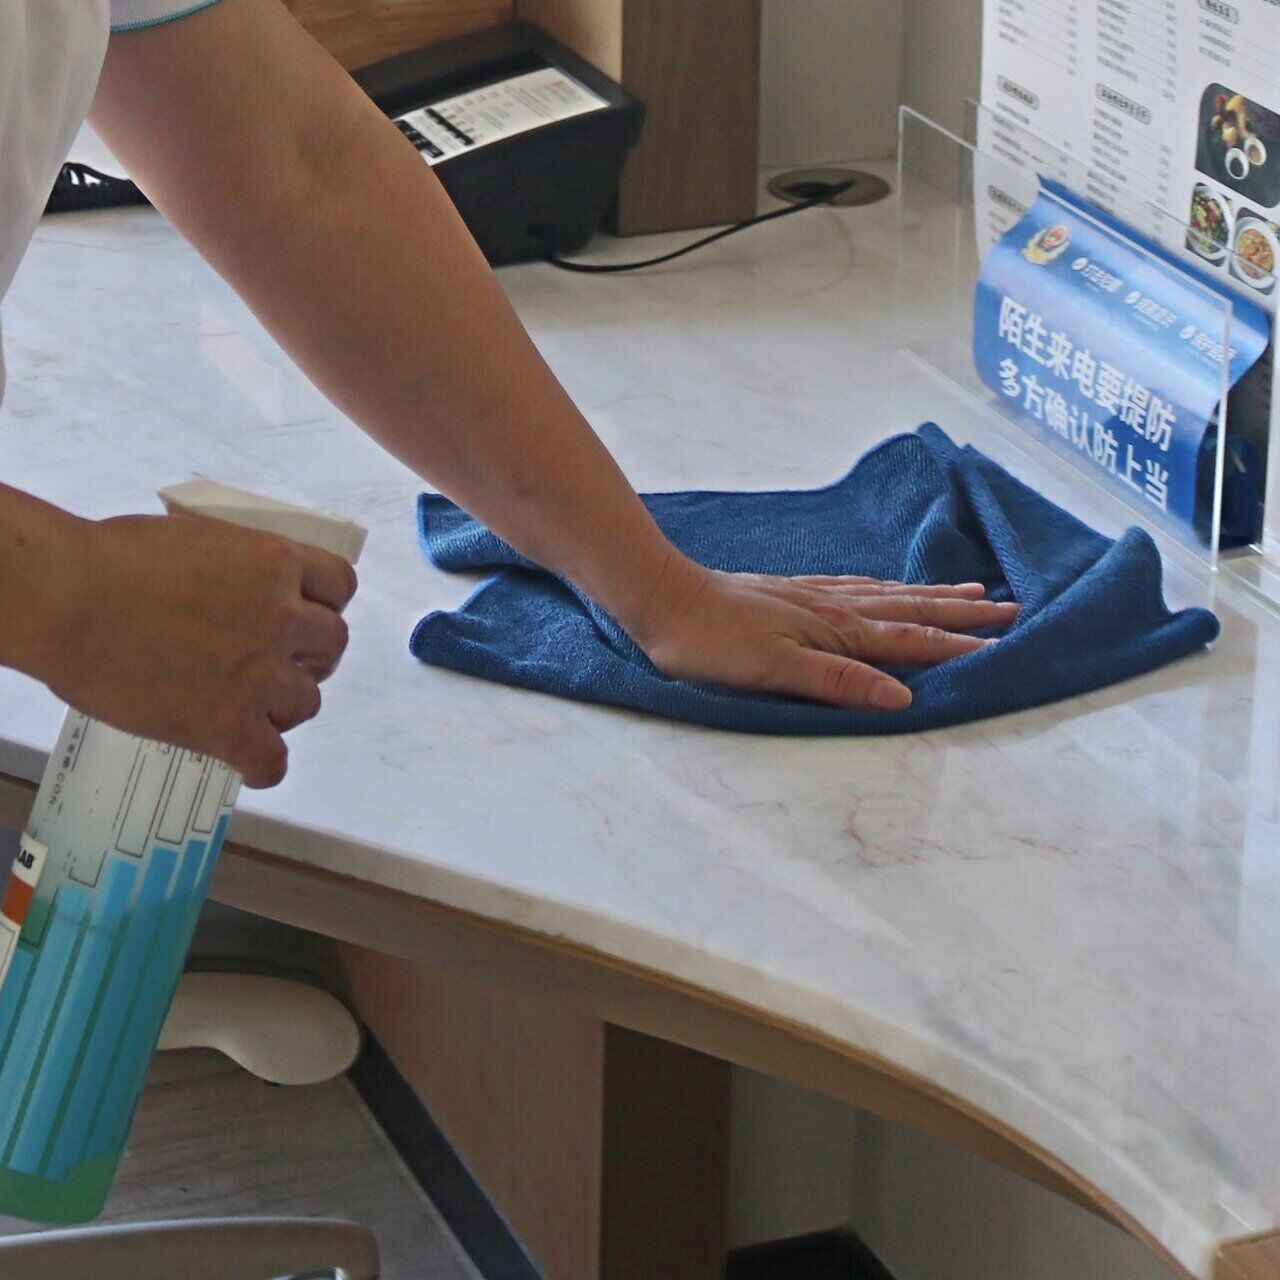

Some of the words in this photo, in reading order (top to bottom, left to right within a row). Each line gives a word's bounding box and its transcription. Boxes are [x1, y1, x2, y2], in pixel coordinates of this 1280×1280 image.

[998, 296, 1176, 451] 陌生来电要提防
[998, 358, 1169, 513] 多方确认防上当
